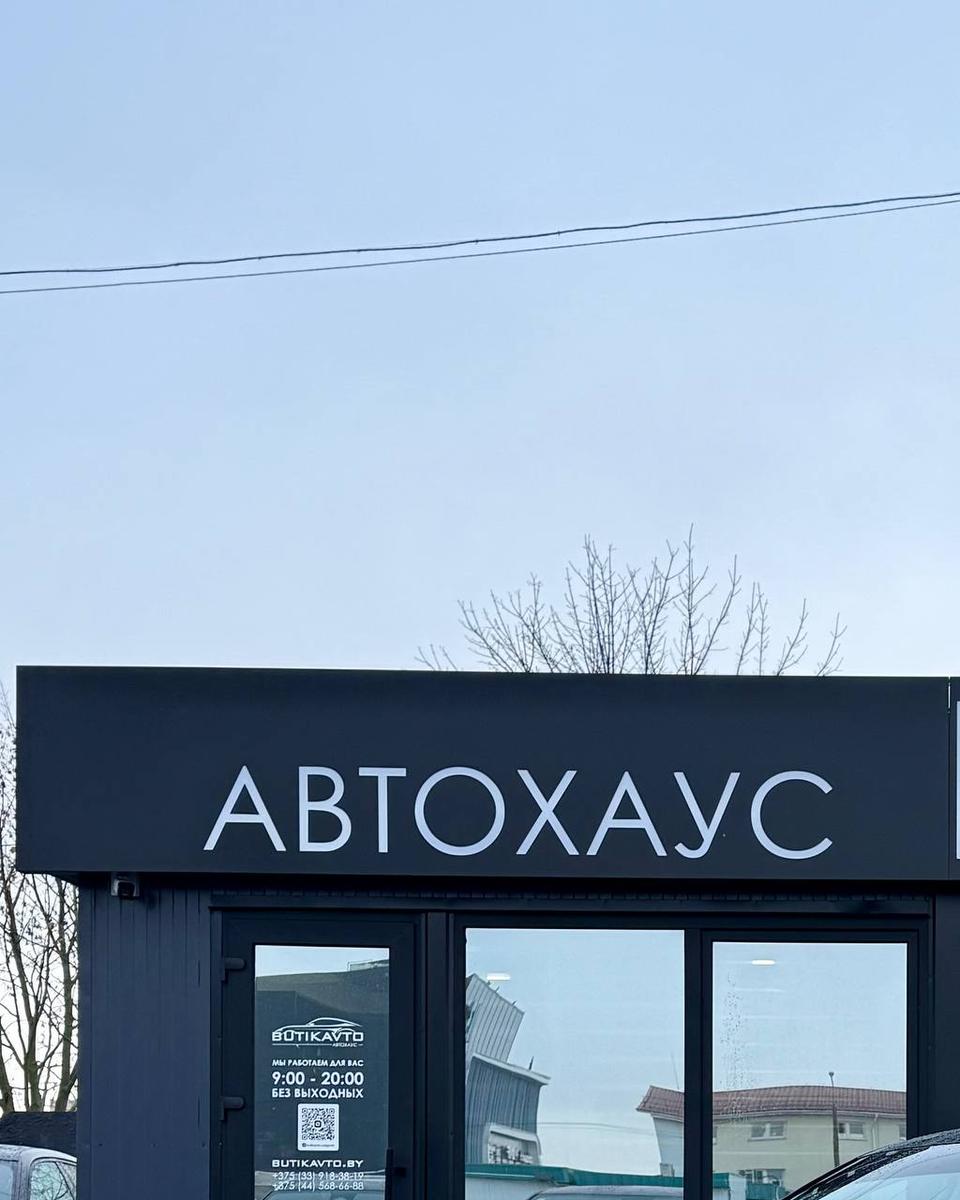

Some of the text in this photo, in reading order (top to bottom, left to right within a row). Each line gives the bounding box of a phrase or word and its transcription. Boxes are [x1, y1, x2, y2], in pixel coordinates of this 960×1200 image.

[204, 766, 833, 860] АВТОХАУС
[272, 1031, 364, 1042] BUTIKAVTO
[272, 1072, 305, 1085] 9:00
[321, 1072, 364, 1085] 20:00
[272, 1088, 364, 1099] БЕЗ ВЫХОДНЫХ
[272, 1160, 364, 1168] BUTIKAVTO.BY
[272, 1171, 364, 1182] +375 (33) 918-38-19
[272, 1181, 364, 1192] +375 (44) 568-66-88
